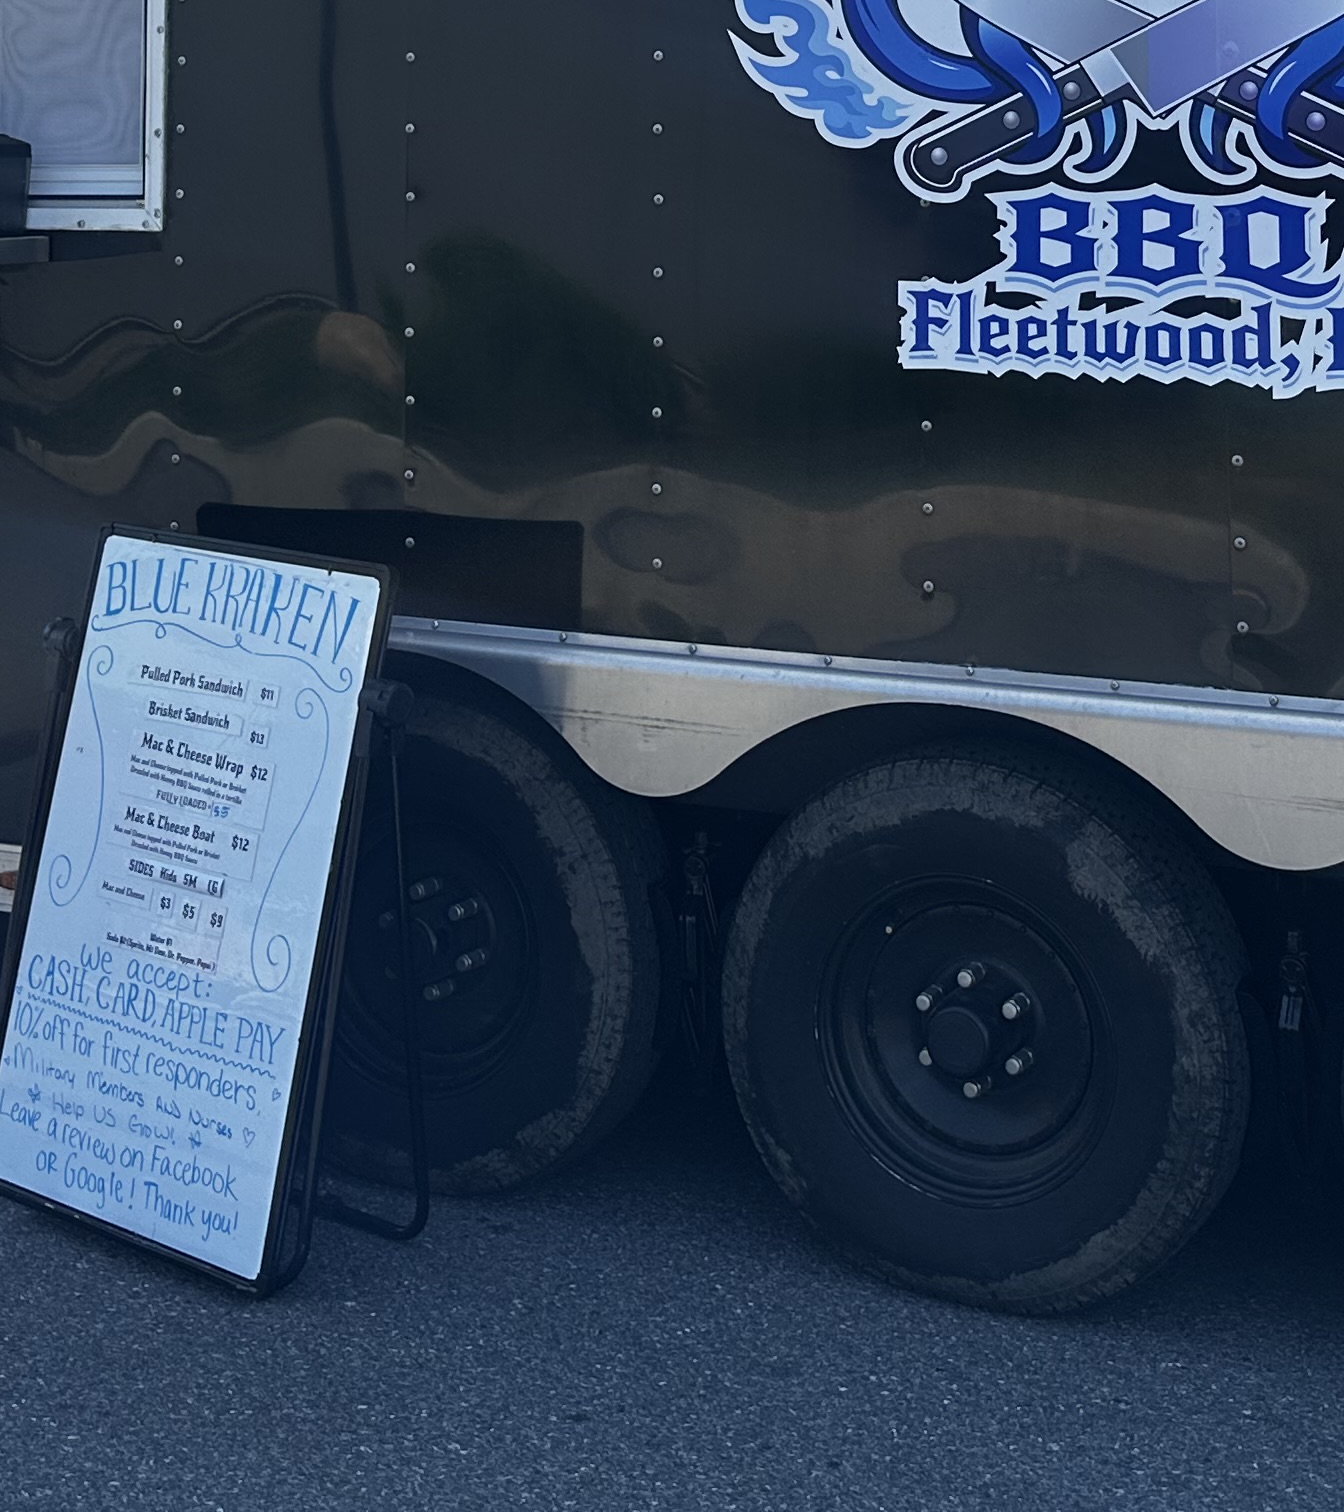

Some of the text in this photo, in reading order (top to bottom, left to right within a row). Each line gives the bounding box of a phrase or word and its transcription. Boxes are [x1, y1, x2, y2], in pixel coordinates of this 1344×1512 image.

[904, 286, 1301, 386] Fleetwood,
[103, 557, 361, 665] BLUE KRAKEN
[141, 665, 274, 700] Pulled Pork Sandwich $11
[149, 701, 264, 744] Brisket Sandwich $13
[141, 732, 268, 781] Mac & Cheese Wrap $12
[124, 806, 249, 851] Mac & Cheese Boat $12
[129, 859, 154, 877] SIDES
[160, 867, 177, 883] Kids
[183, 874, 197, 888] SM
[102, 881, 114, 891] Mac
[160, 897, 171, 910] $3
[182, 903, 195, 919] $5
[210, 912, 223, 928] $9
[127, 959, 212, 998] accept:
[28, 955, 285, 1064] CASH, CARD, APPLE PAY
[14, 1001, 44, 1039] 10%
[43, 1015, 70, 1050] off
[73, 1022, 94, 1057] for
[103, 1031, 140, 1076] first
[14, 1043, 75, 1089] Military
[87, 1071, 144, 1107] Members
[189, 1109, 232, 1139] Nurses
[52, 1093, 84, 1120] Help
[0, 1089, 239, 1200] Leave a review on Facebook
[144, 1181, 195, 1226] Thank
[202, 1210, 238, 1241] you!
